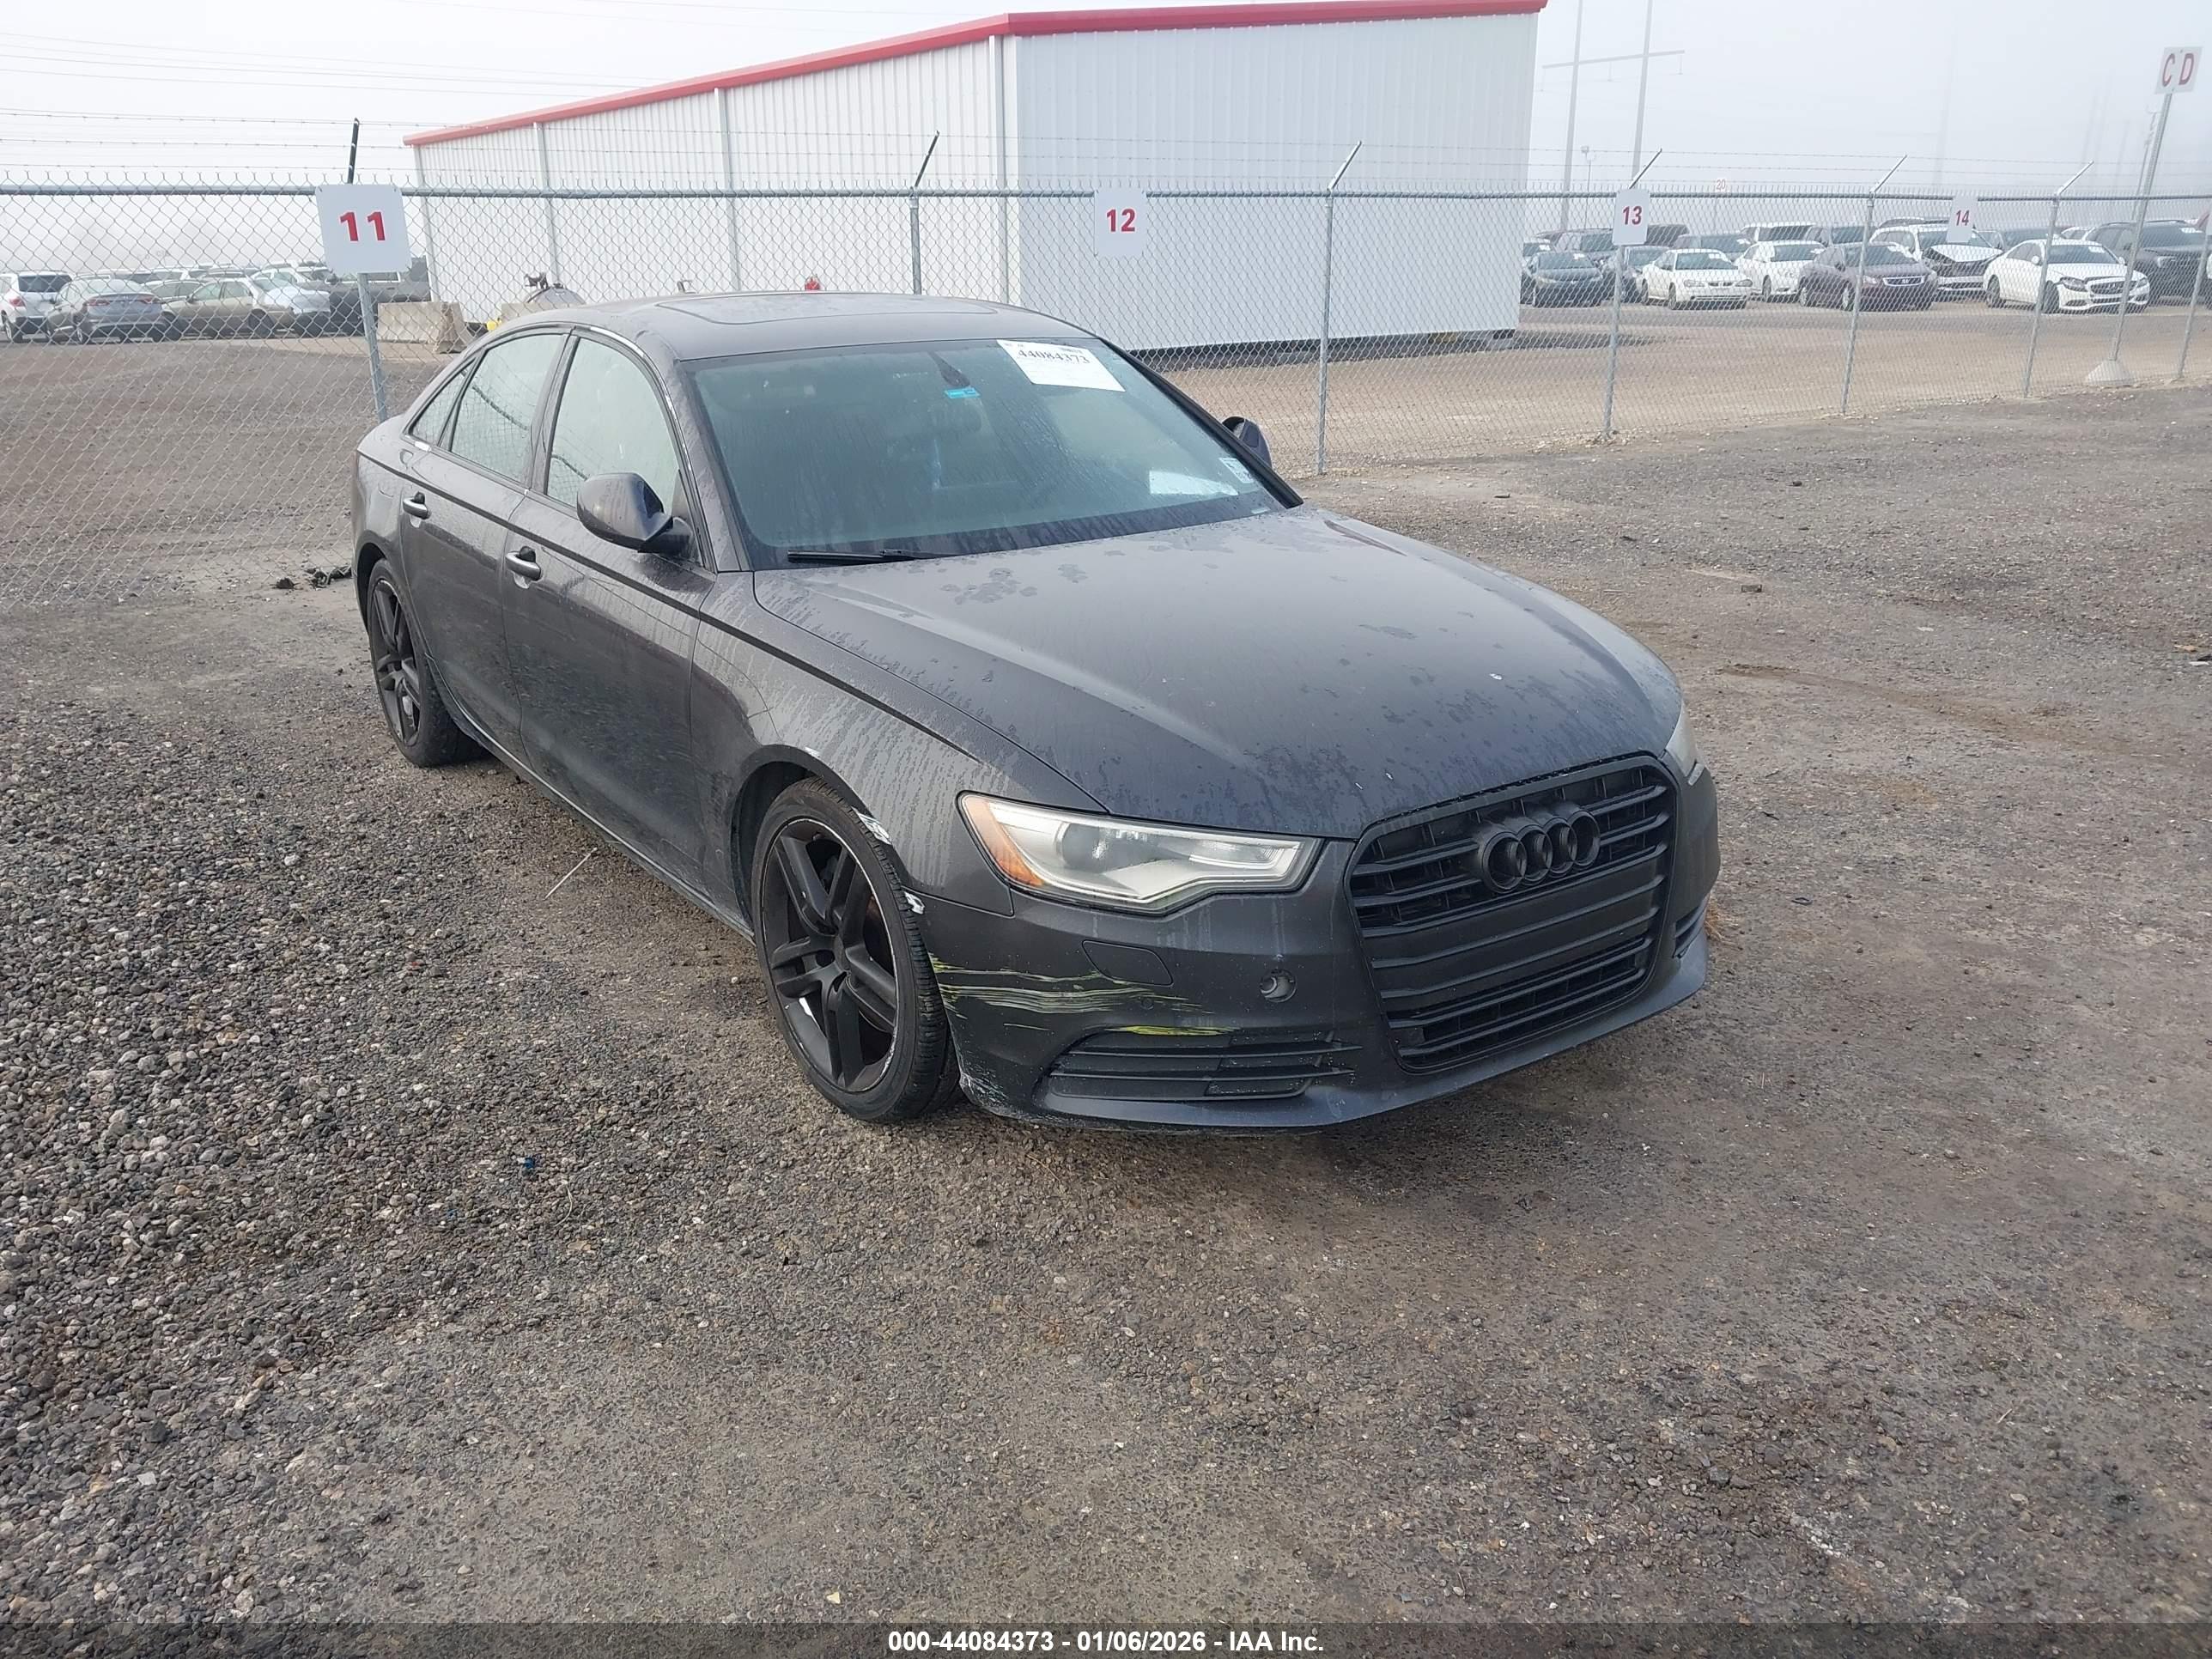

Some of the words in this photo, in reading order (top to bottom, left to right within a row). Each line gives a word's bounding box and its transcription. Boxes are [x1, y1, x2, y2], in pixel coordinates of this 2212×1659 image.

[1106, 208, 1136, 233] 12
[1622, 205, 1644, 226] 13
[1956, 210, 1970, 227] 14
[340, 211, 386, 242] 11
[1018, 349, 1090, 364] 44084373
